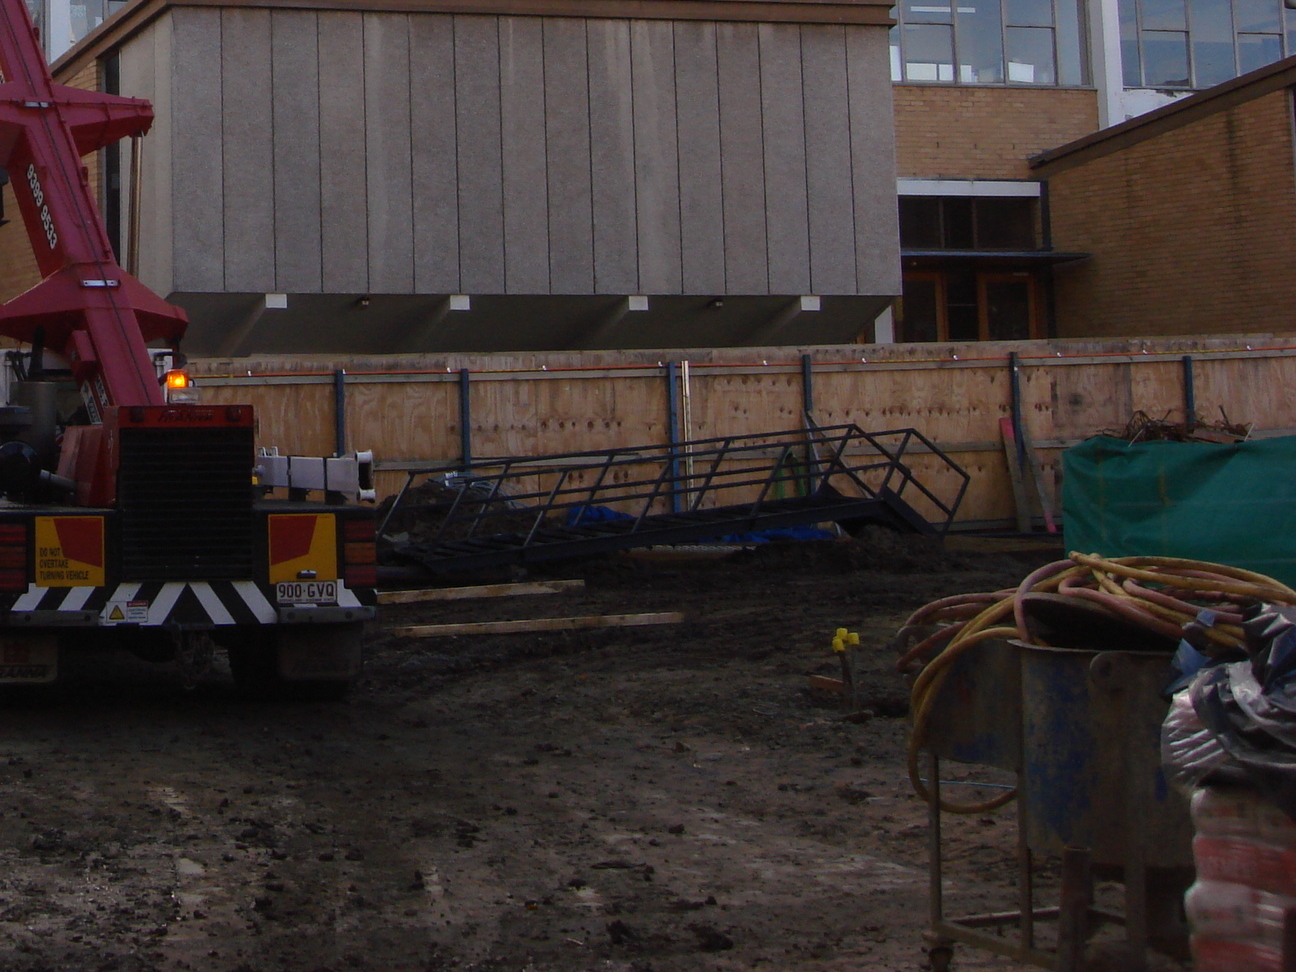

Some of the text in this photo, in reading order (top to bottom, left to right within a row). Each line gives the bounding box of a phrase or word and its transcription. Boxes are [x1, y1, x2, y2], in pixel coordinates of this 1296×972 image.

[27, 163, 57, 249] 9399 9533
[39, 547, 60, 557] DO NOT
[39, 559, 69, 569] OVERTAKE
[40, 570, 89, 580] TURNING VEHICLE
